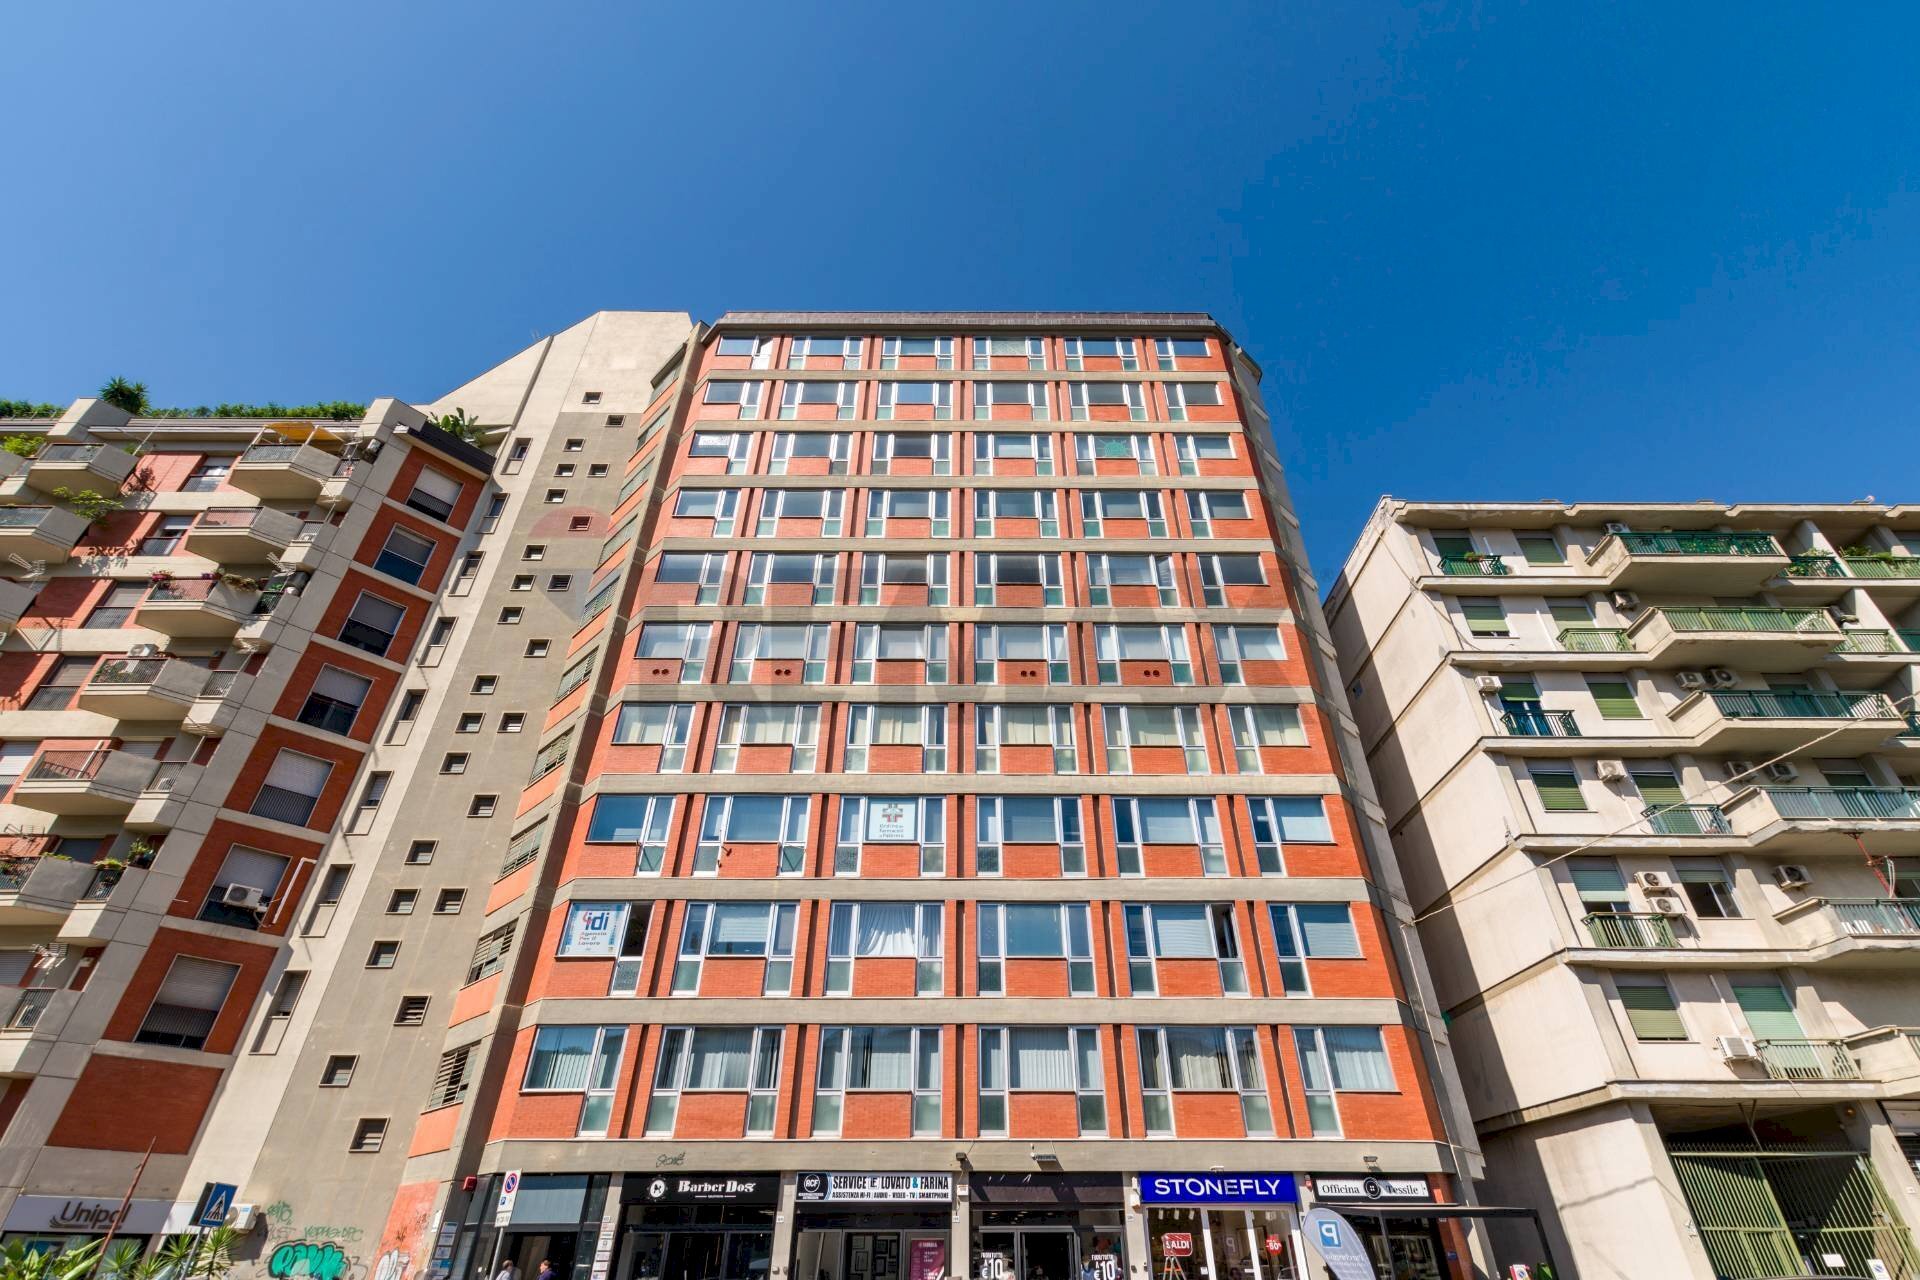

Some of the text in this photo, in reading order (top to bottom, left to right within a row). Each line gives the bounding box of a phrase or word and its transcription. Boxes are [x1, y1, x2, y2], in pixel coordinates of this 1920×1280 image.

[677, 1180, 757, 1193] Barber Dog
[832, 1176, 866, 1190] SERVICE
[881, 1176, 911, 1189] LOVATO
[912, 1176, 919, 1188] &
[920, 1176, 949, 1189] FARINA
[1154, 1177, 1281, 1196] STONEFLY
[1322, 1184, 1419, 1195] Officina Tessile
[60, 1200, 132, 1230] Unipol
